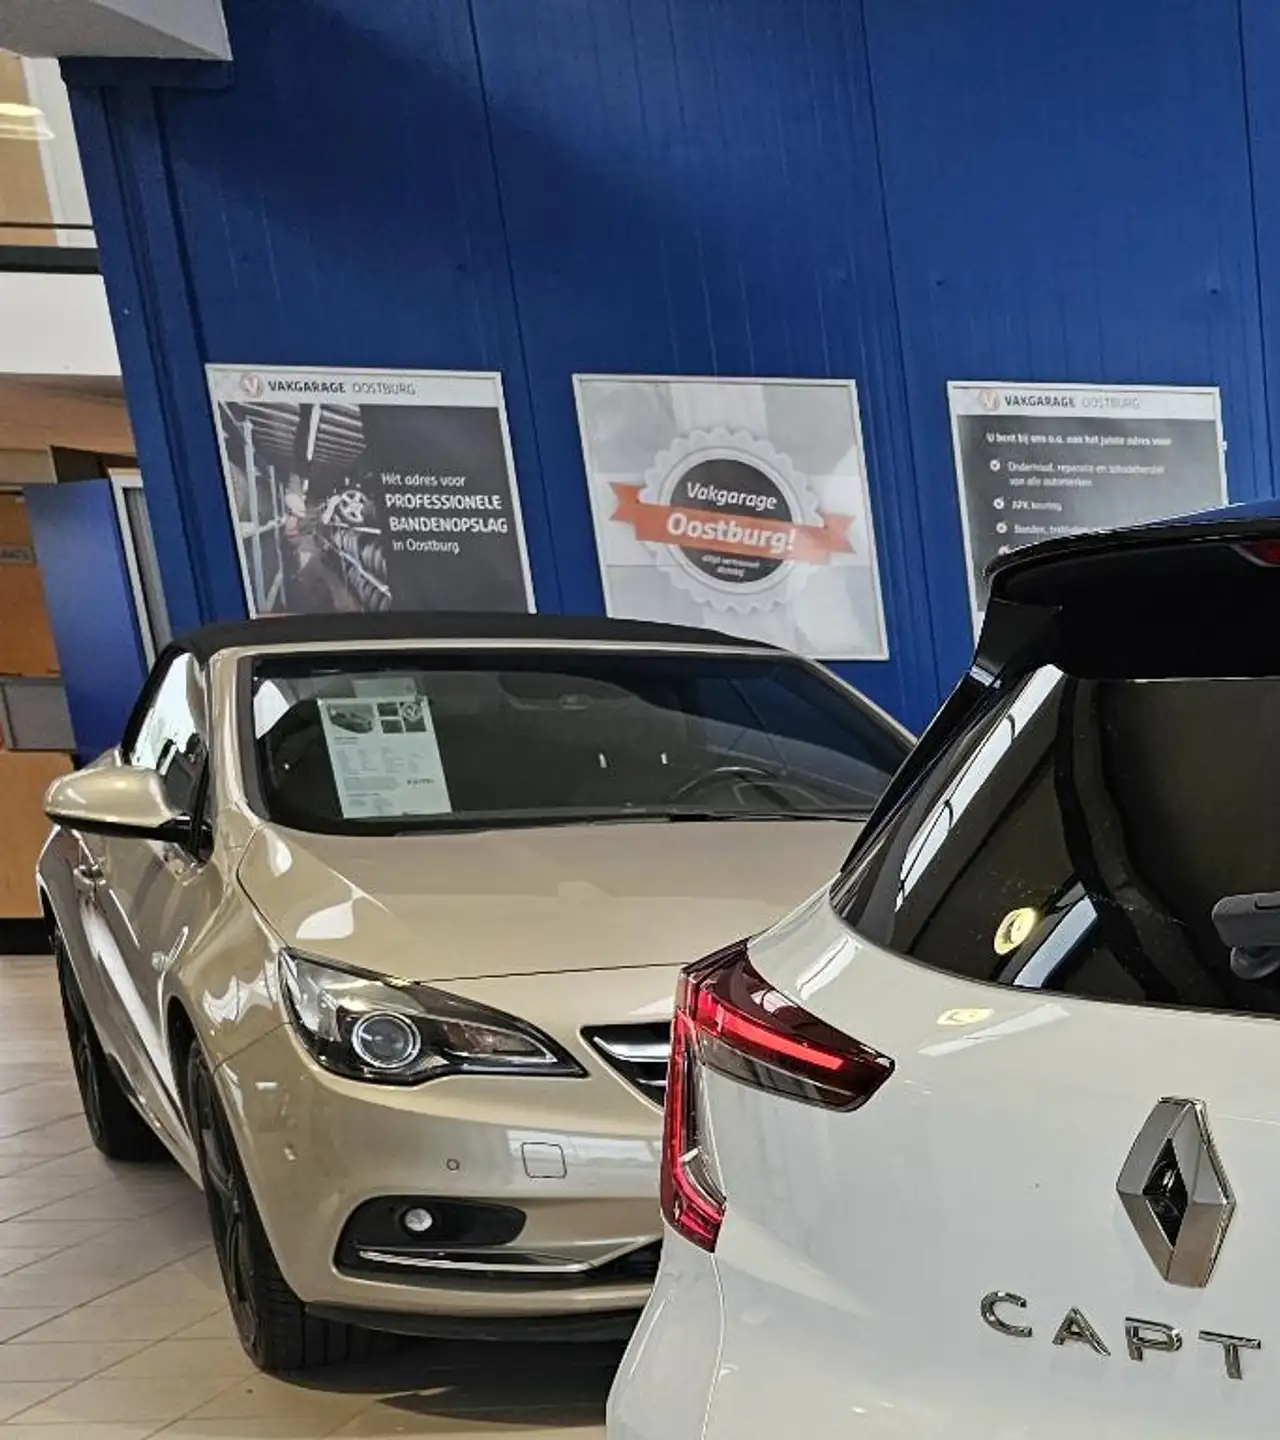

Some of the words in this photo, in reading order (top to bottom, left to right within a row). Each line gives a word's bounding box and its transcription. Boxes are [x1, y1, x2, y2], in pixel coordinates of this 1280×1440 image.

[268, 380, 346, 393] VAKGARAGE
[352, 382, 416, 395] OOSTBURG
[1004, 395, 1075, 408] VAKGARAGE
[404, 474, 438, 486] adres
[440, 476, 466, 487] voor
[385, 493, 502, 510] PROFESSIONELE
[687, 482, 777, 511] Vakgarage
[389, 516, 508, 533] BANDENOPSLAG
[666, 512, 796, 554] Oostburg!
[392, 540, 404, 551] in
[406, 538, 460, 555] Oostburg
